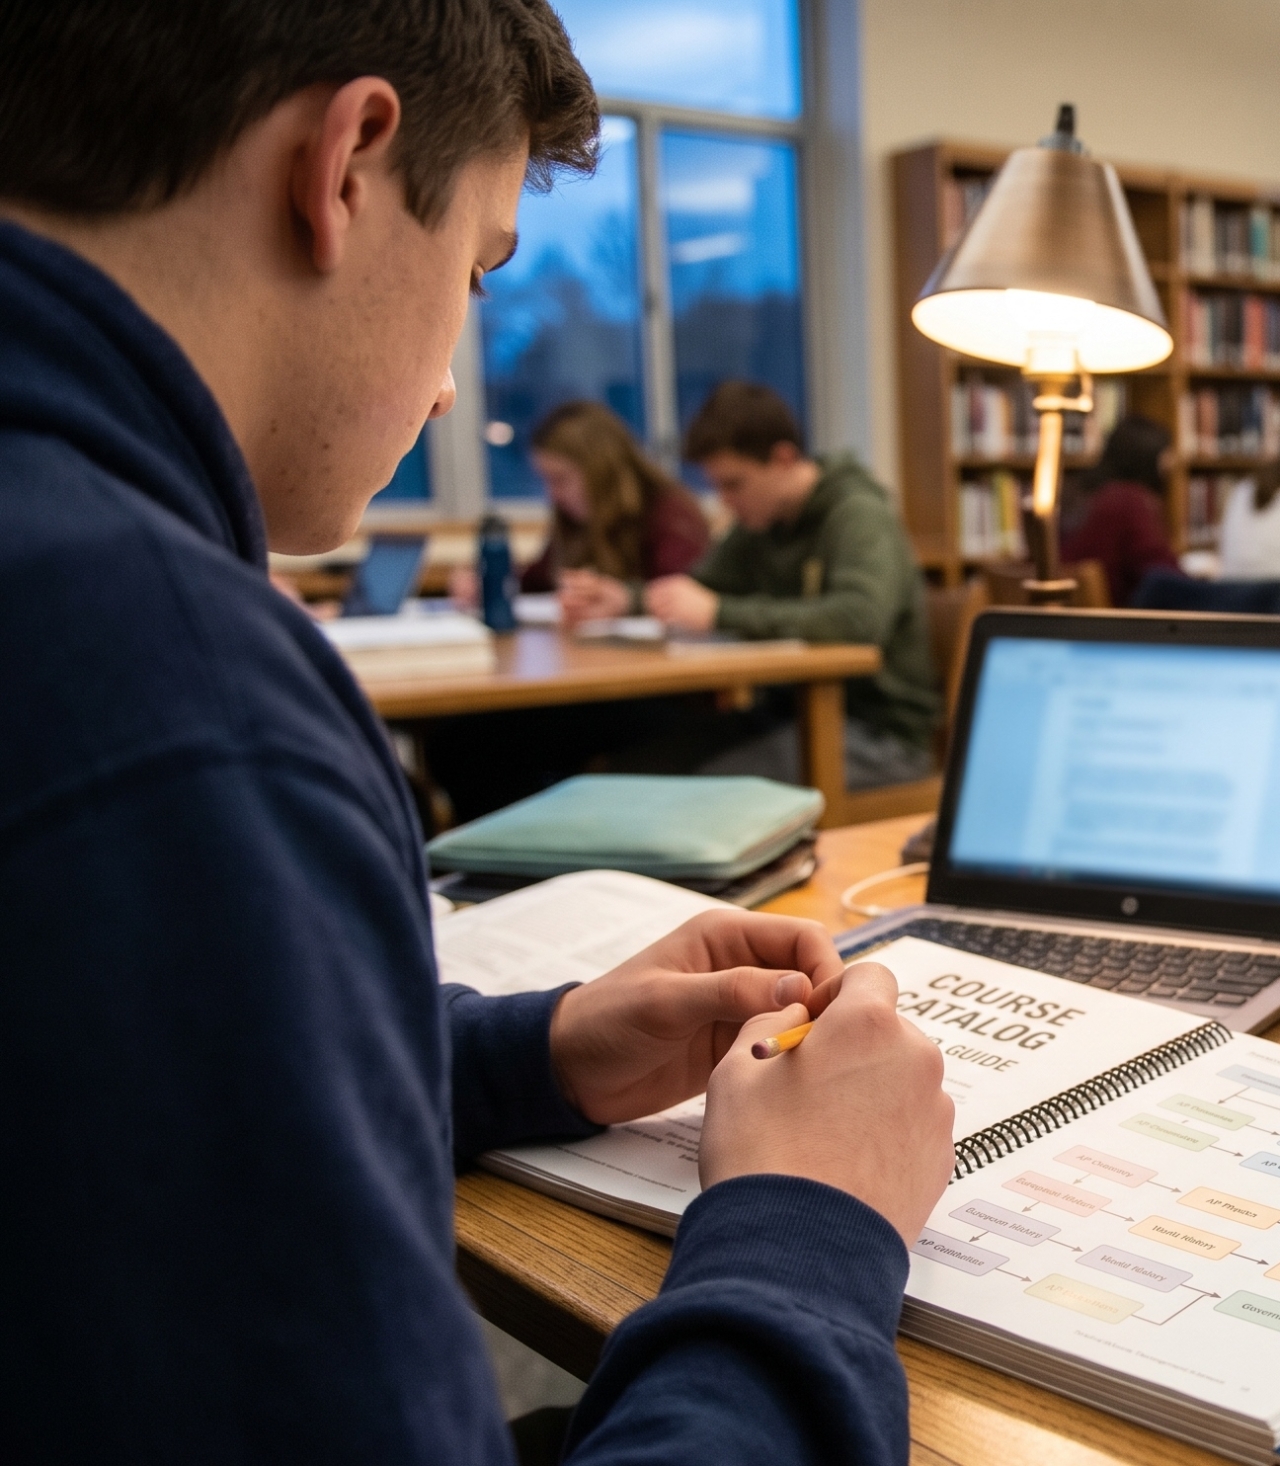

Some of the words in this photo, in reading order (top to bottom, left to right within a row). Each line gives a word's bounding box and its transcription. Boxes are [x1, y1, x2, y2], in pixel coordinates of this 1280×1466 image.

[896, 991, 1056, 1051] CATALOG
[928, 974, 1086, 1027] COURSE
[945, 1044, 1019, 1073] GUIDE
